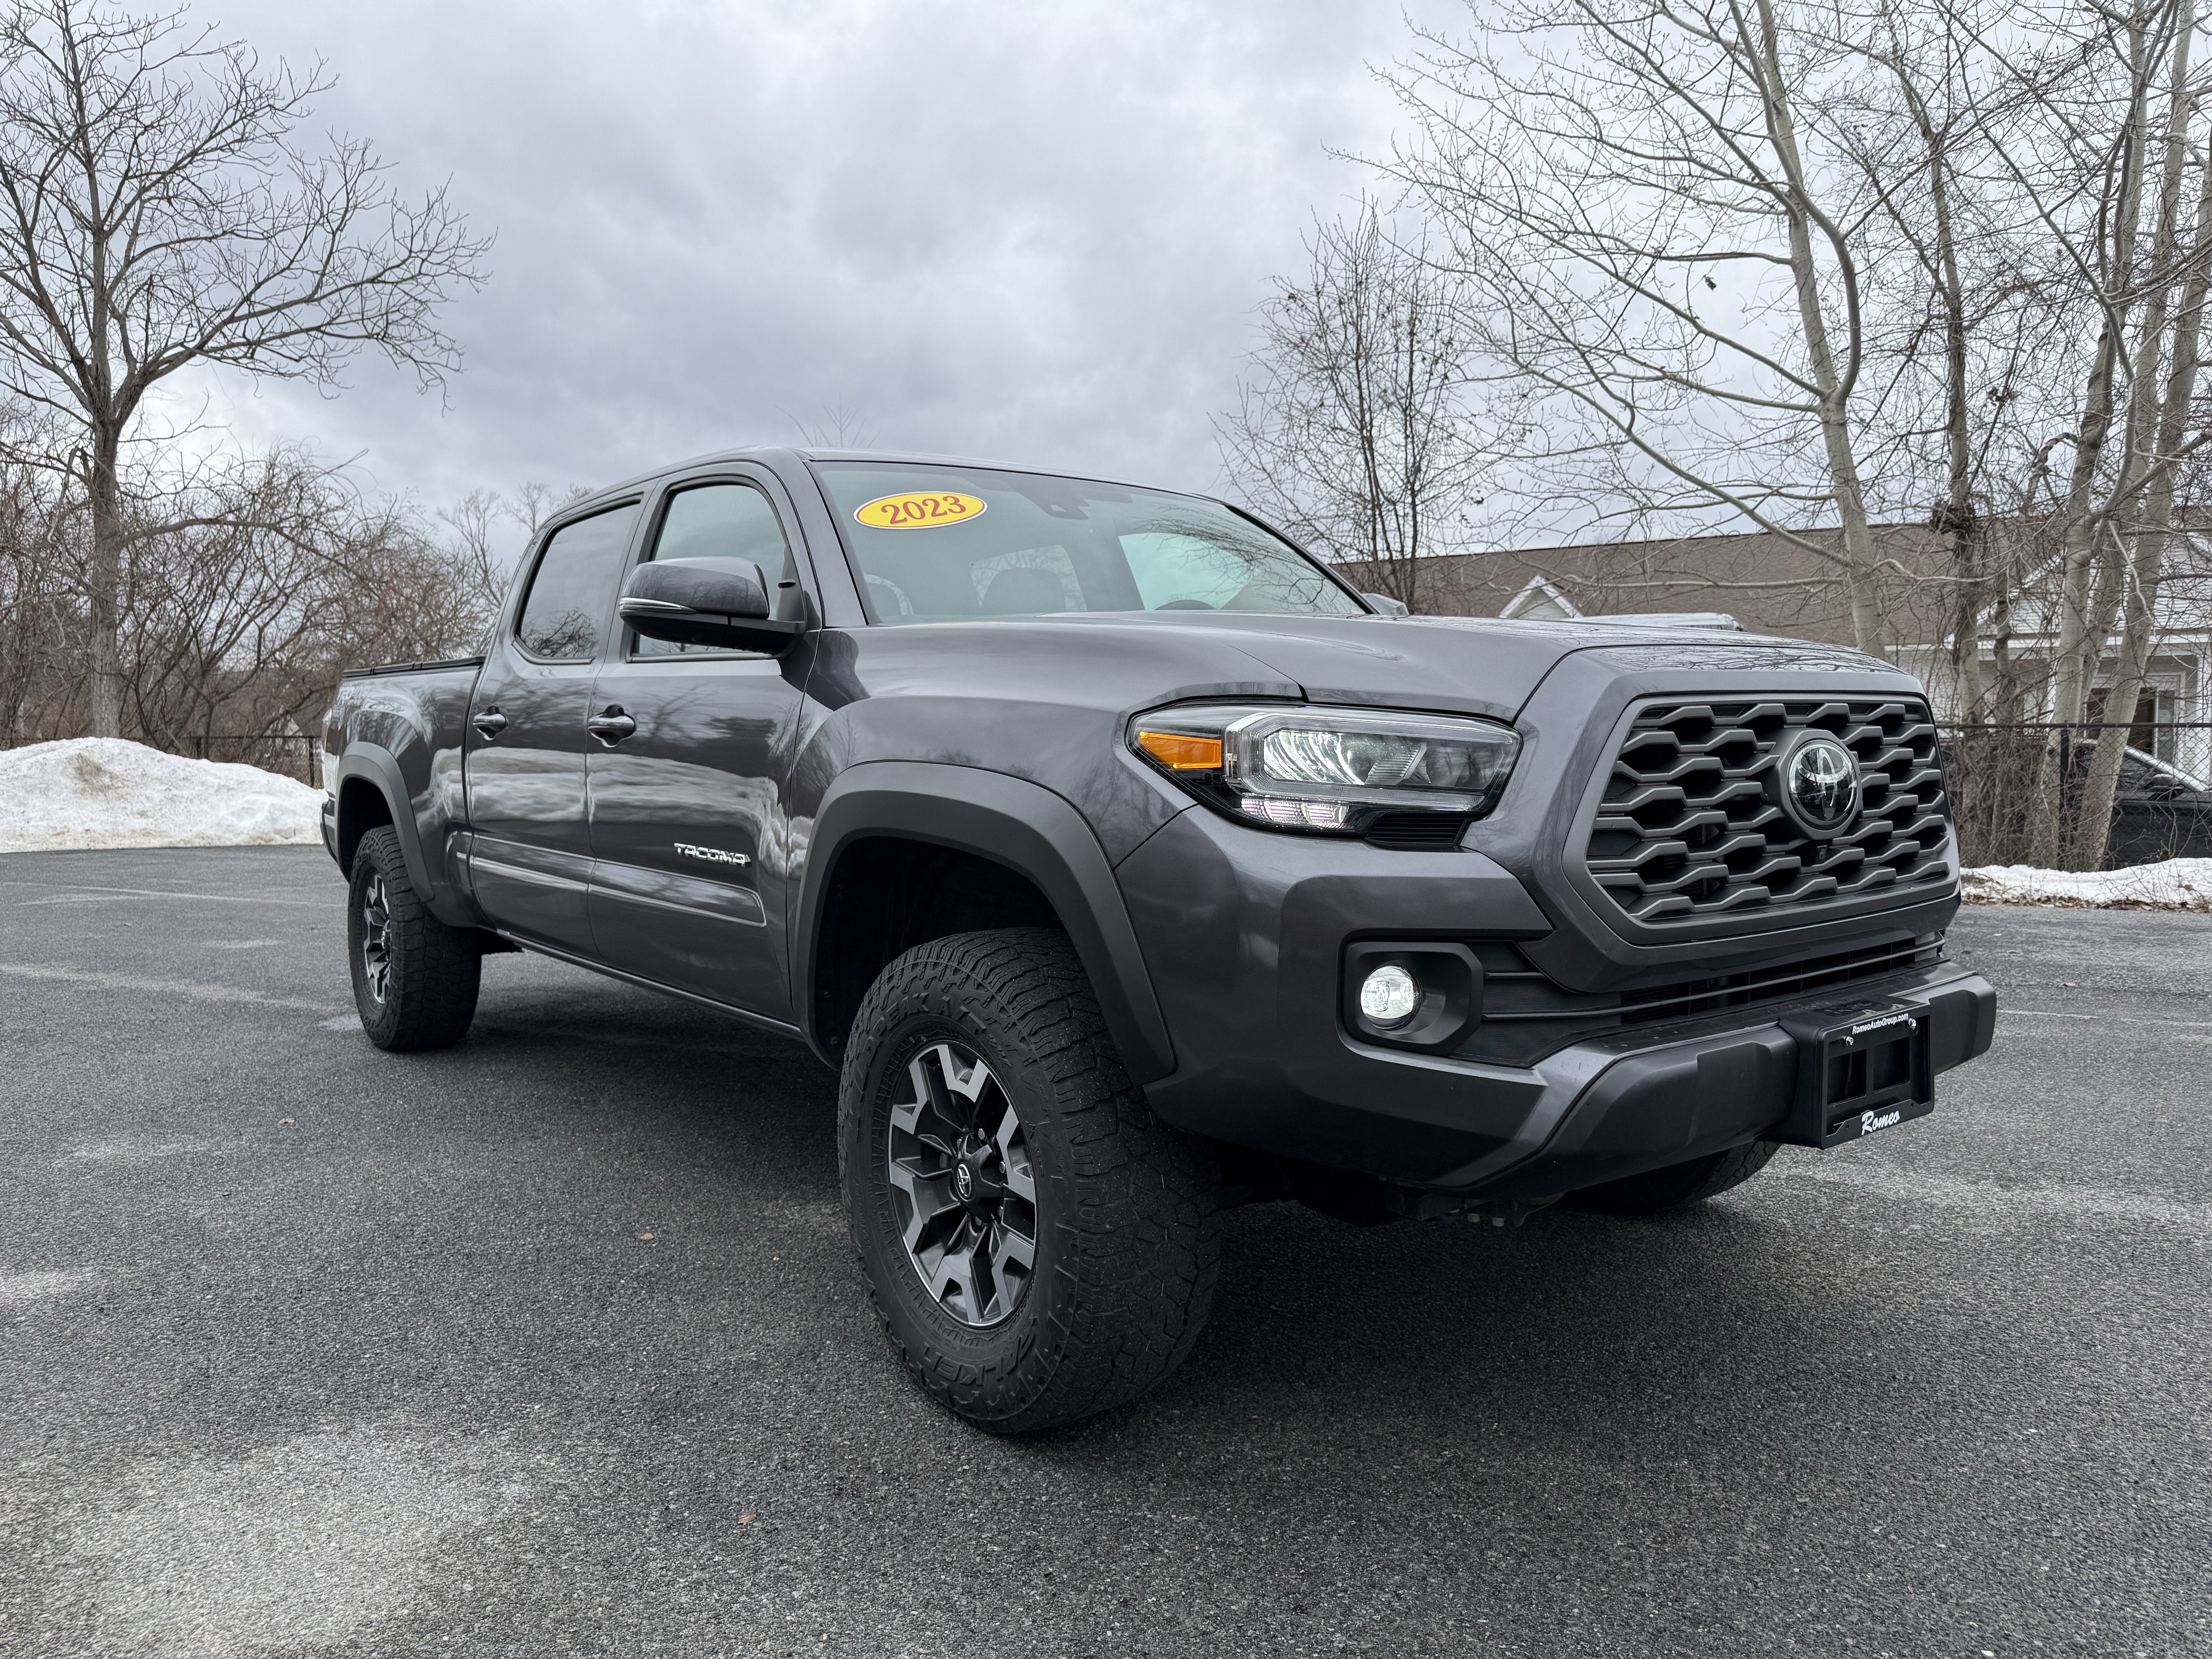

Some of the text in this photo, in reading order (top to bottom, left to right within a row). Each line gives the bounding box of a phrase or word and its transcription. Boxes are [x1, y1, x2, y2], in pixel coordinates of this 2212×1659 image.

[881, 496, 966, 524] 2023
[674, 843, 752, 868] TACOMA
[1852, 1013, 1908, 1035] RomeoAutoGroup.com
[1861, 1111, 1900, 1135] Romeo
